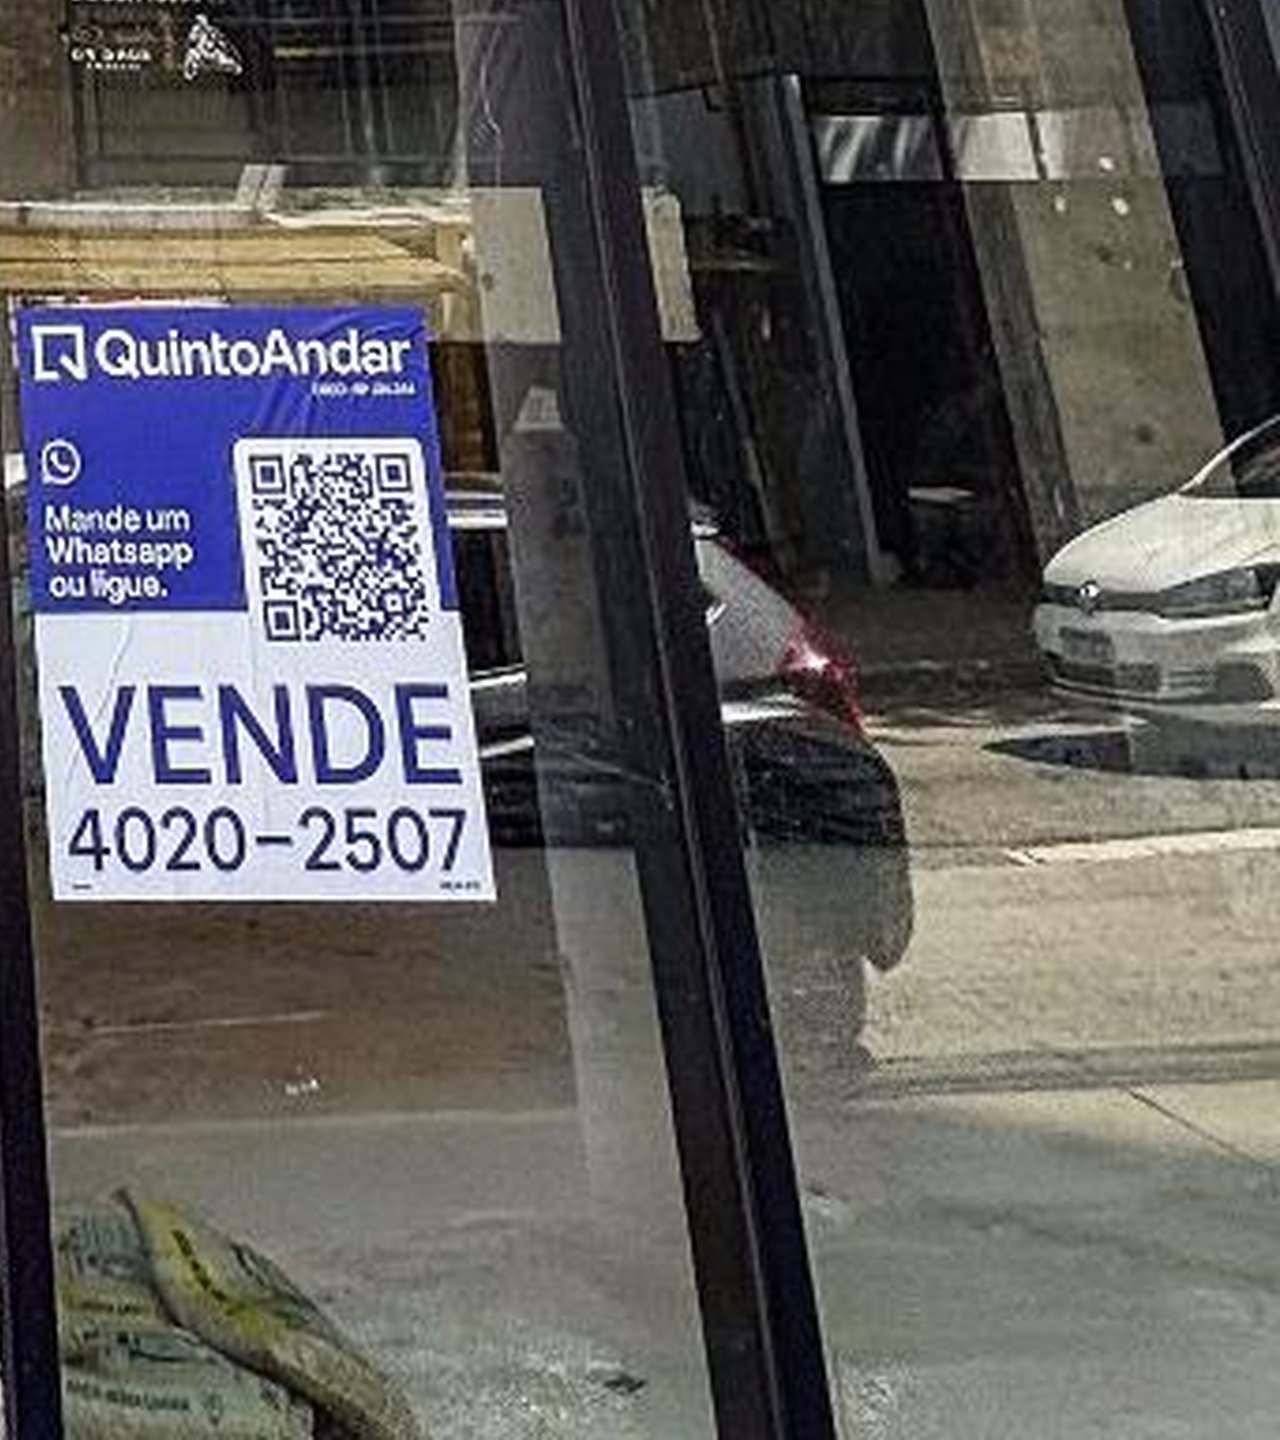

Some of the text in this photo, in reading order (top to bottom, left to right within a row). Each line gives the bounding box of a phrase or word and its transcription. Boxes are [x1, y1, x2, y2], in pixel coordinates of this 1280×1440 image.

[94, 329, 410, 379] QuintoAndar
[45, 505, 190, 531] Mande um
[45, 536, 193, 570] Whatsapp
[49, 569, 168, 604] ou ligue.
[58, 683, 463, 786] VENDE
[67, 805, 467, 873] 4020-2507
